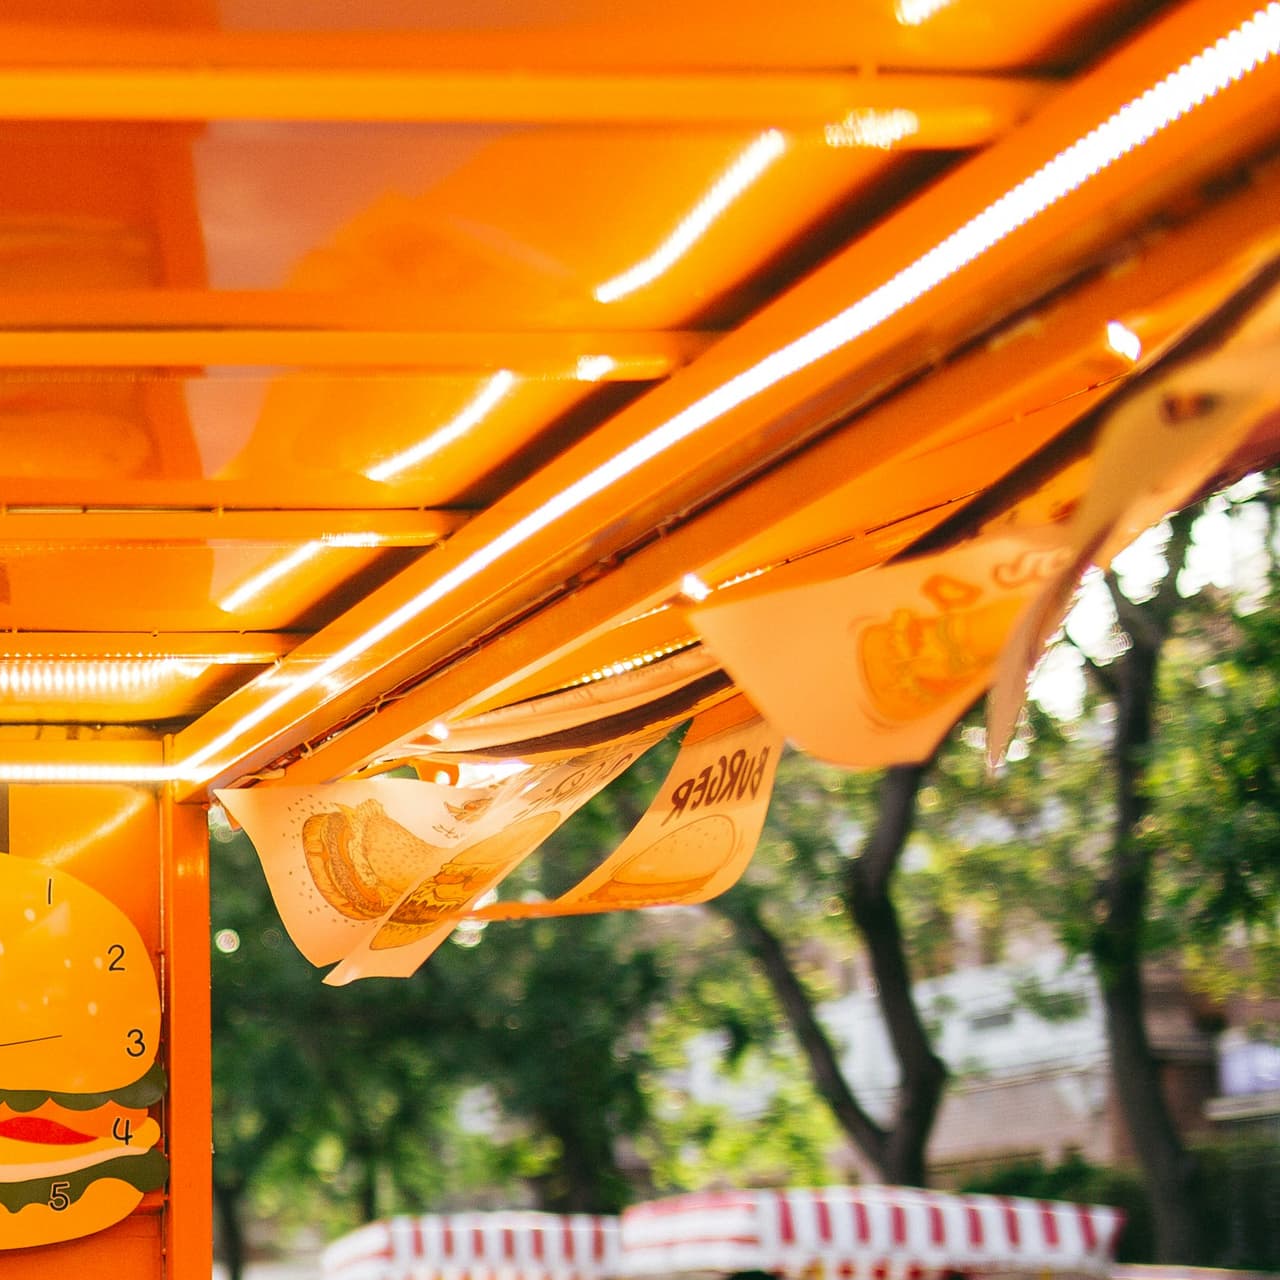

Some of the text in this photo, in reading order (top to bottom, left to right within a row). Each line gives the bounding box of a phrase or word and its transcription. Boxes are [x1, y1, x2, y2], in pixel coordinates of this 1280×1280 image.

[46, 878, 53, 905] 1
[108, 944, 126, 972] 2
[126, 1029, 146, 1057] 3
[113, 1117, 133, 1145] 4
[49, 1184, 70, 1211] 5
